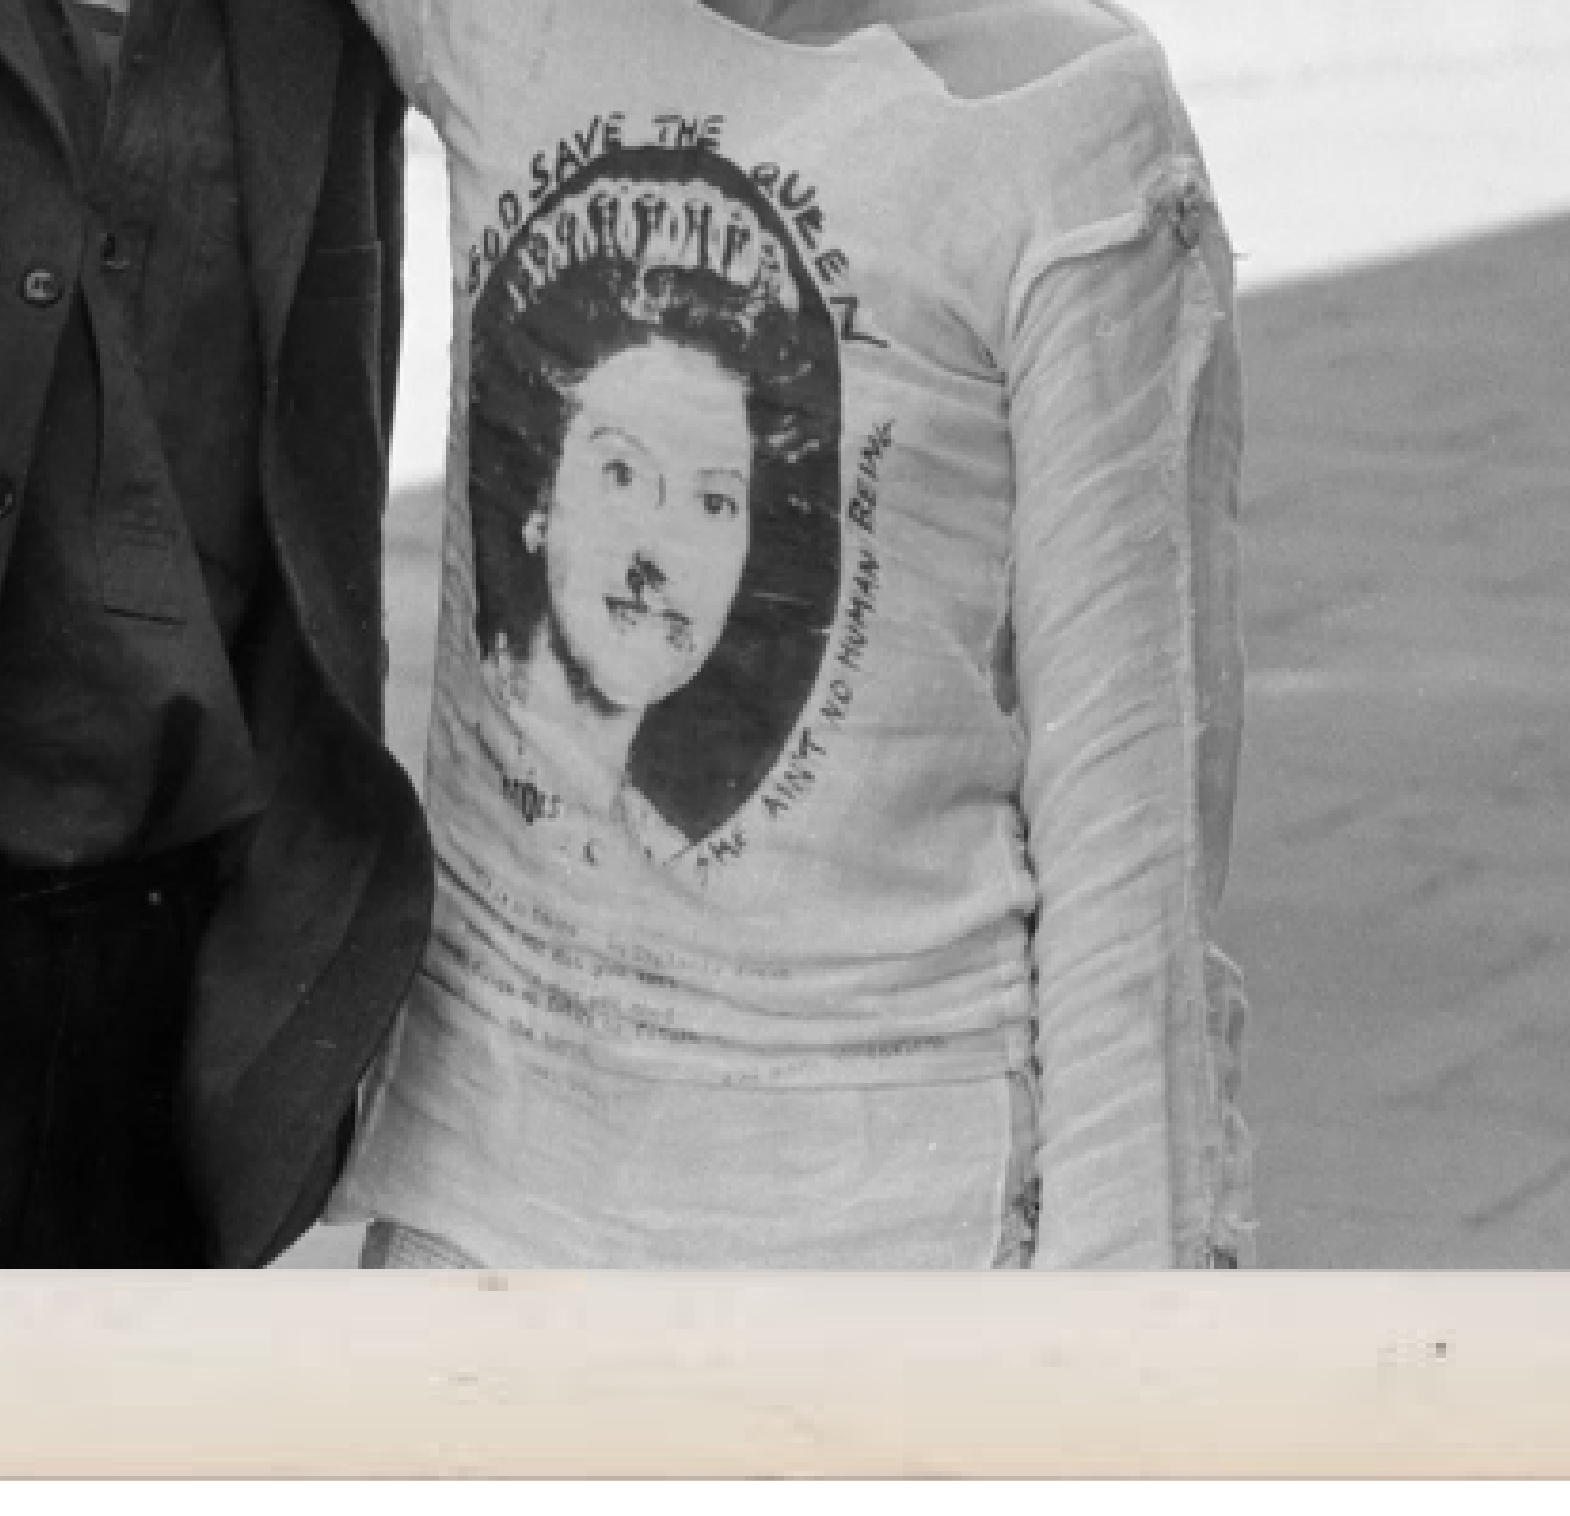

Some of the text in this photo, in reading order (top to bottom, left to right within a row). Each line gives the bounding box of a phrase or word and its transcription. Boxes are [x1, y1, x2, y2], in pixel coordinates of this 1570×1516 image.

[529, 111, 626, 197] SAVE
[651, 114, 726, 152] THE
[747, 161, 890, 348] QUEEN
[833, 548, 880, 664] HUMAN
[820, 679, 854, 720] NO
